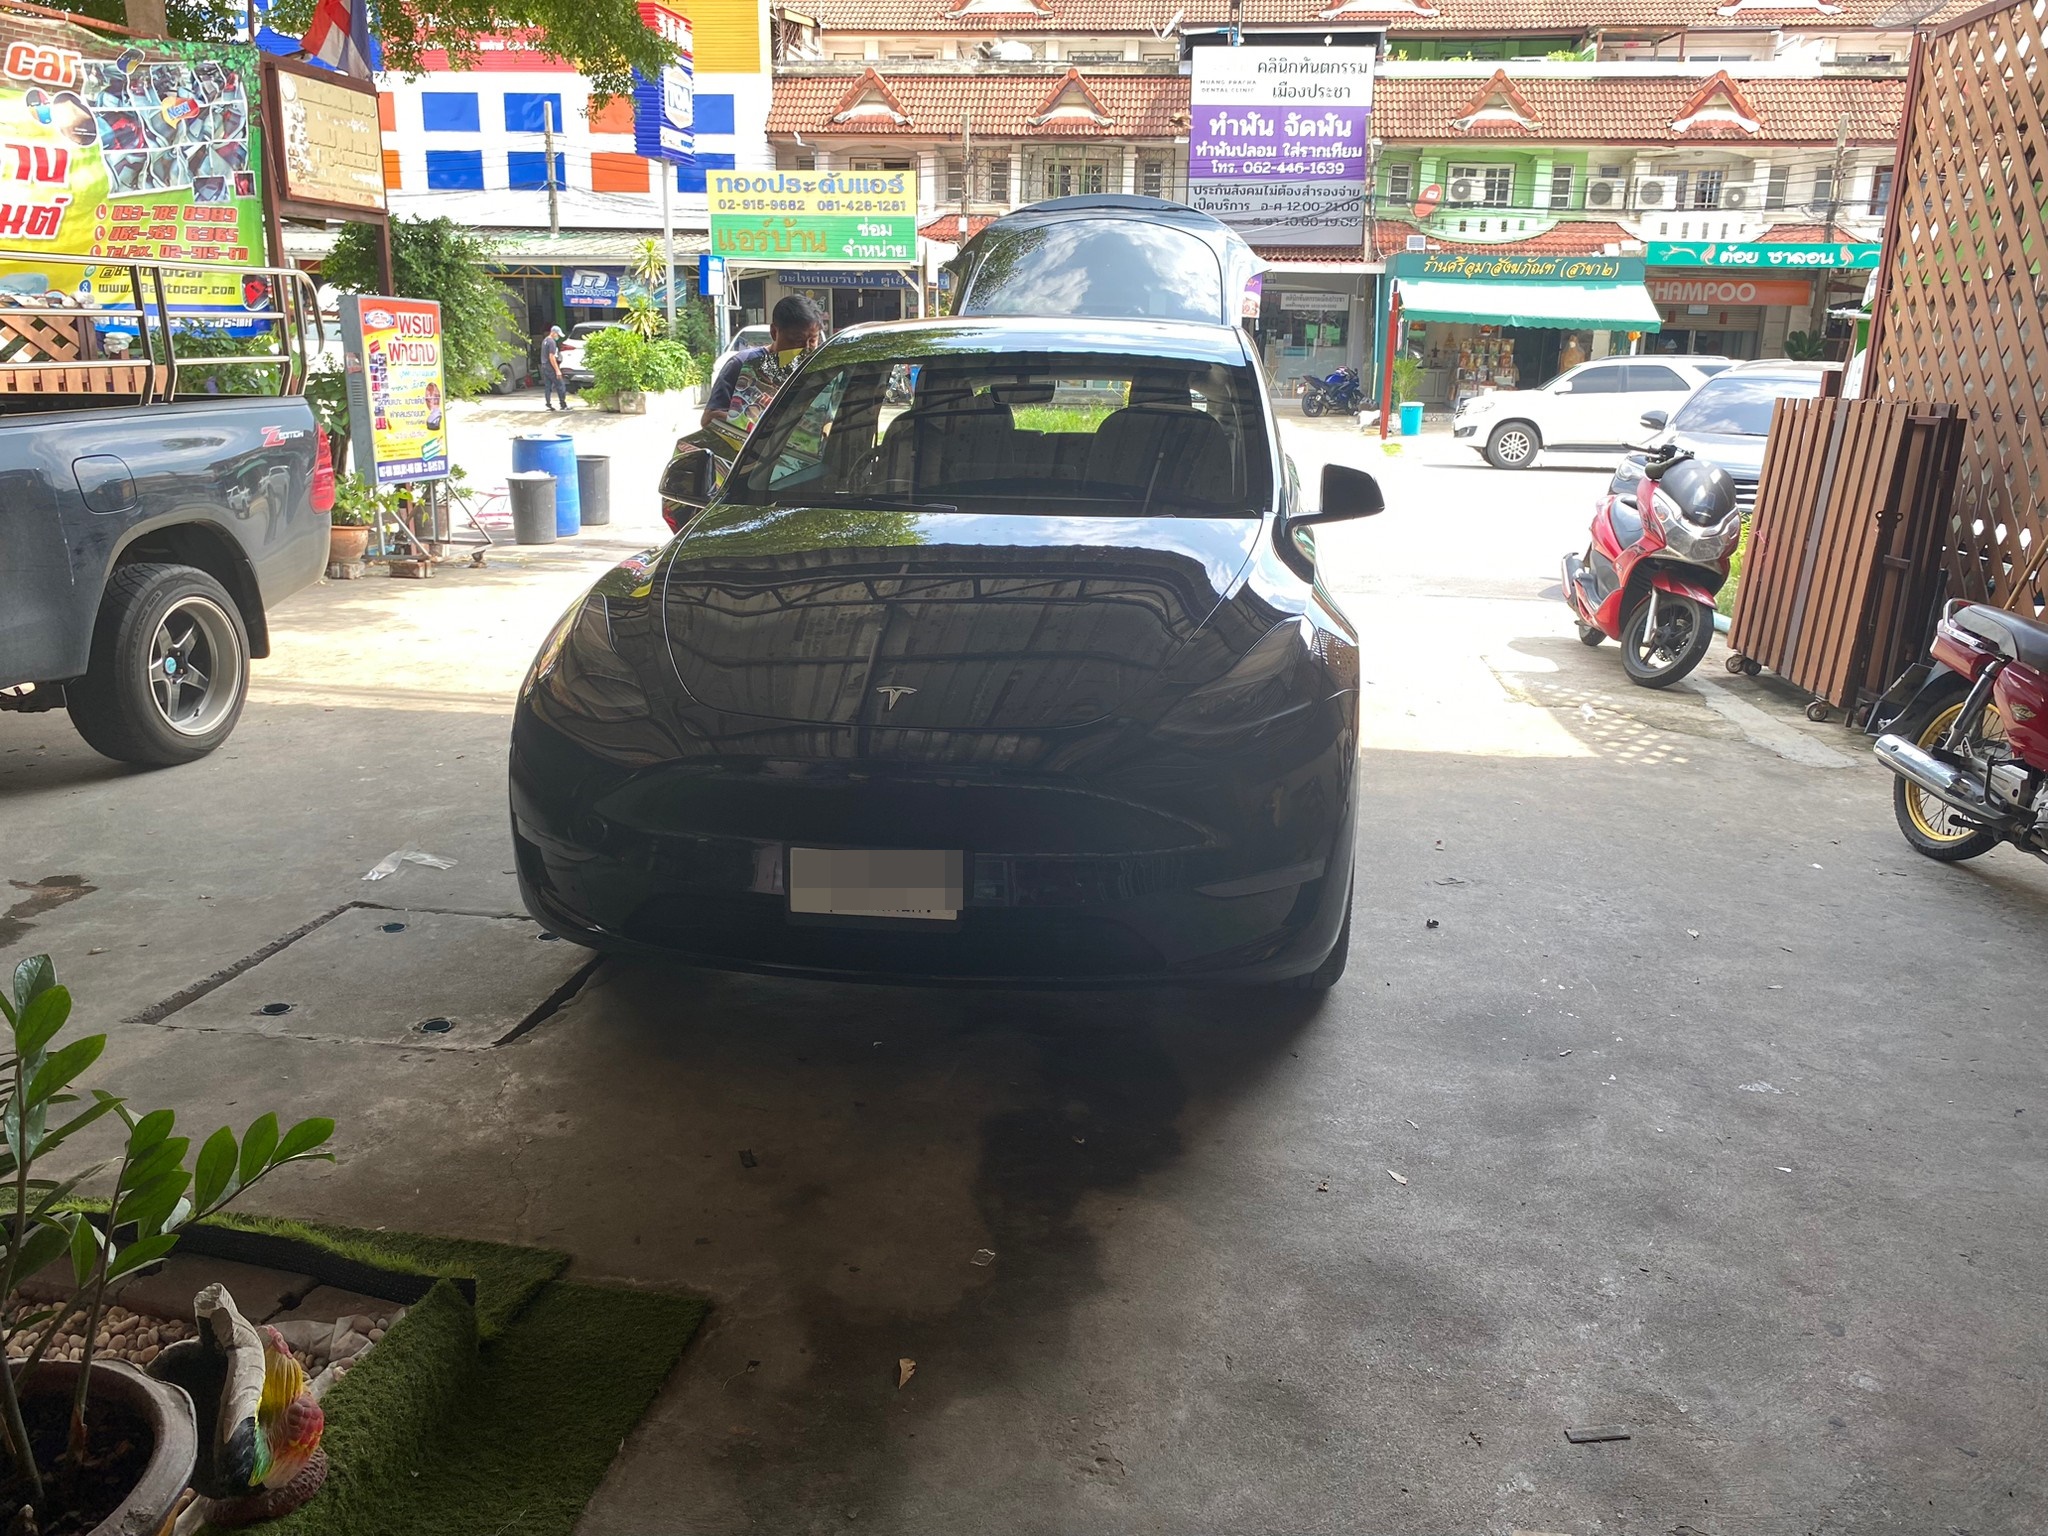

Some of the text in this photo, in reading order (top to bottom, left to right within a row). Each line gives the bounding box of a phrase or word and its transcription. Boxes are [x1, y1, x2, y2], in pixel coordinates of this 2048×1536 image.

[7, 46, 79, 83] car
[1257, 56, 1368, 74] คลินิกทันตกรรม
[1272, 81, 1351, 99] เมืองประชา
[1208, 111, 1352, 138] ทำฟัน จัดฟัน
[1195, 140, 1363, 159] ทำฟันปลอม ใส่รากเทียม
[1211, 160, 1345, 175] โทร. 062-446-1639
[715, 172, 905, 195] ทองประดับแอร์
[1193, 183, 1361, 197] ประกันสังคมไม่ต้องสำรองจ่าย
[182, 205, 238, 223] 8989
[718, 198, 907, 212] 02-915-9682 081-428-1281
[1193, 197, 1251, 211] เปิดบริการ
[186, 226, 239, 243] 6365
[717, 217, 828, 253] แอร์บ้าน
[856, 216, 893, 237] ซ่อม
[841, 238, 908, 259] จำหน่าย
[1719, 244, 1759, 265] ต้อย
[1423, 255, 1563, 279] ร้านศรีอุมาสังฆภัณฑ์
[1646, 281, 1757, 302] SHAMPOO
[398, 314, 433, 335] พรม
